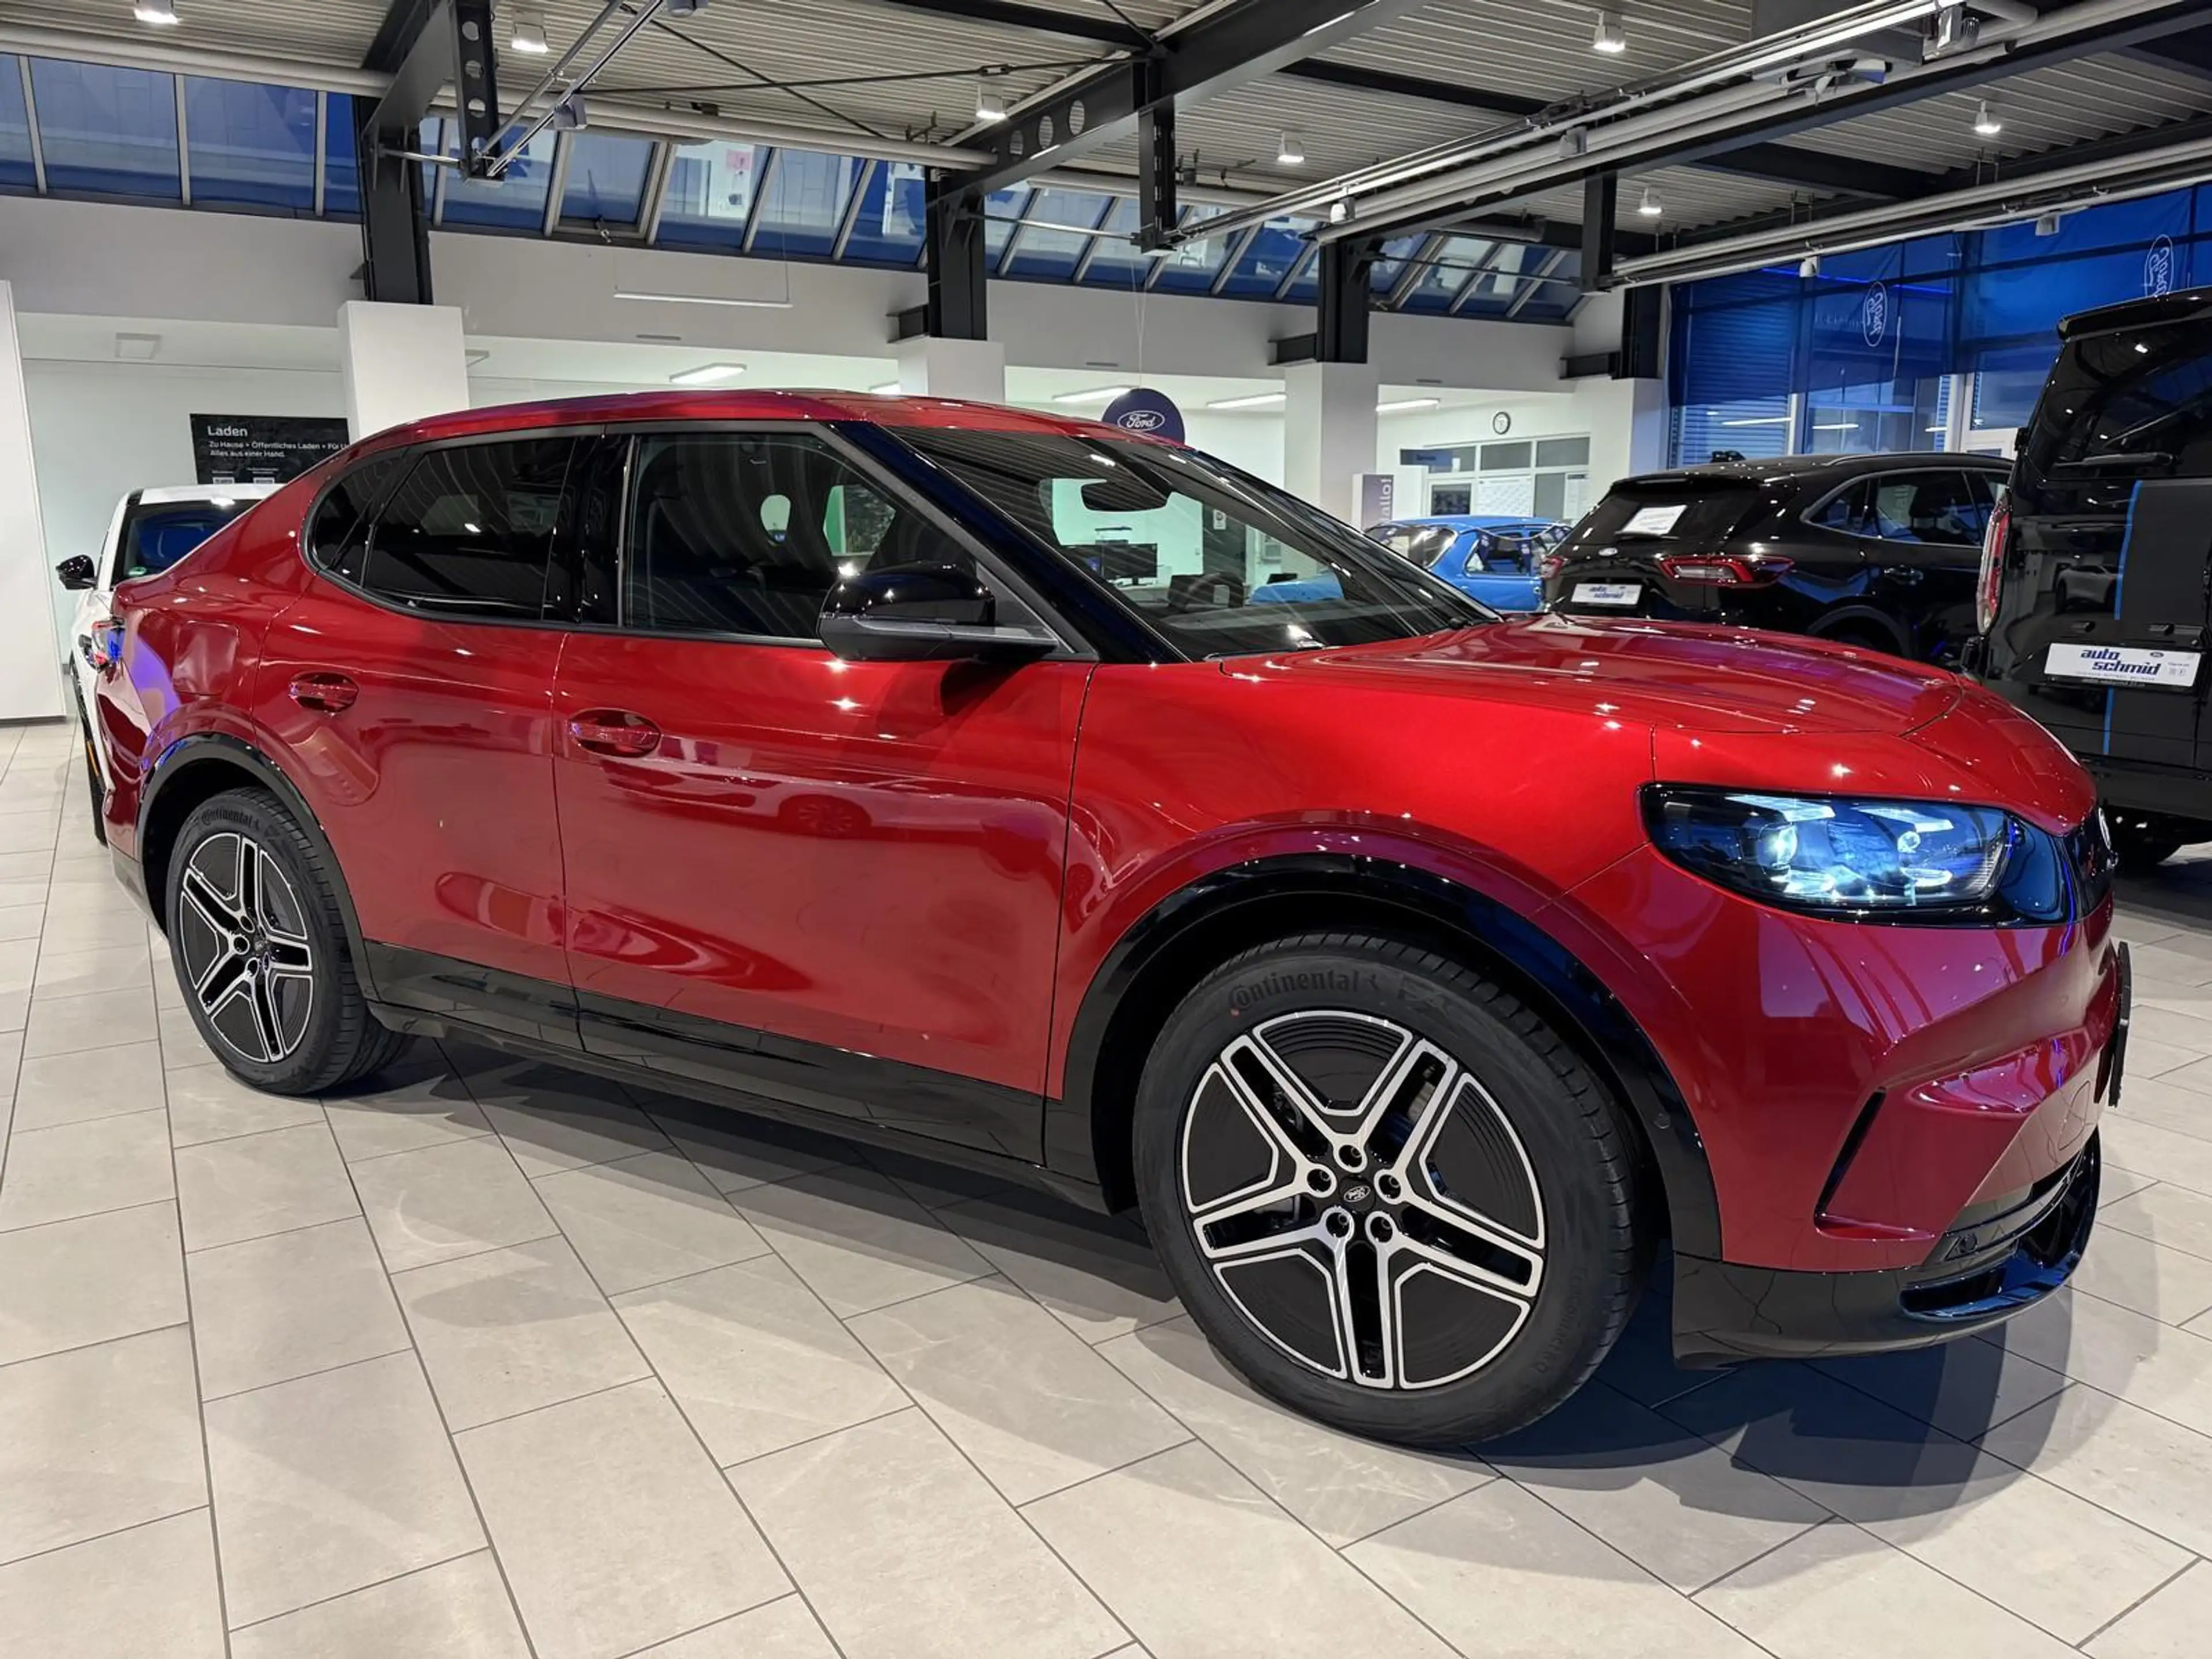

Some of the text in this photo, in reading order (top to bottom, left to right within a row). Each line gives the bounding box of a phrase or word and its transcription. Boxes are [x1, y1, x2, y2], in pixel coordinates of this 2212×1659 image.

[1127, 413, 1156, 428] Ford
[207, 425, 248, 437] Laden
[2080, 648, 2120, 660] auto
[2092, 660, 2161, 675] schmid
[1228, 969, 1360, 1009] Continental
